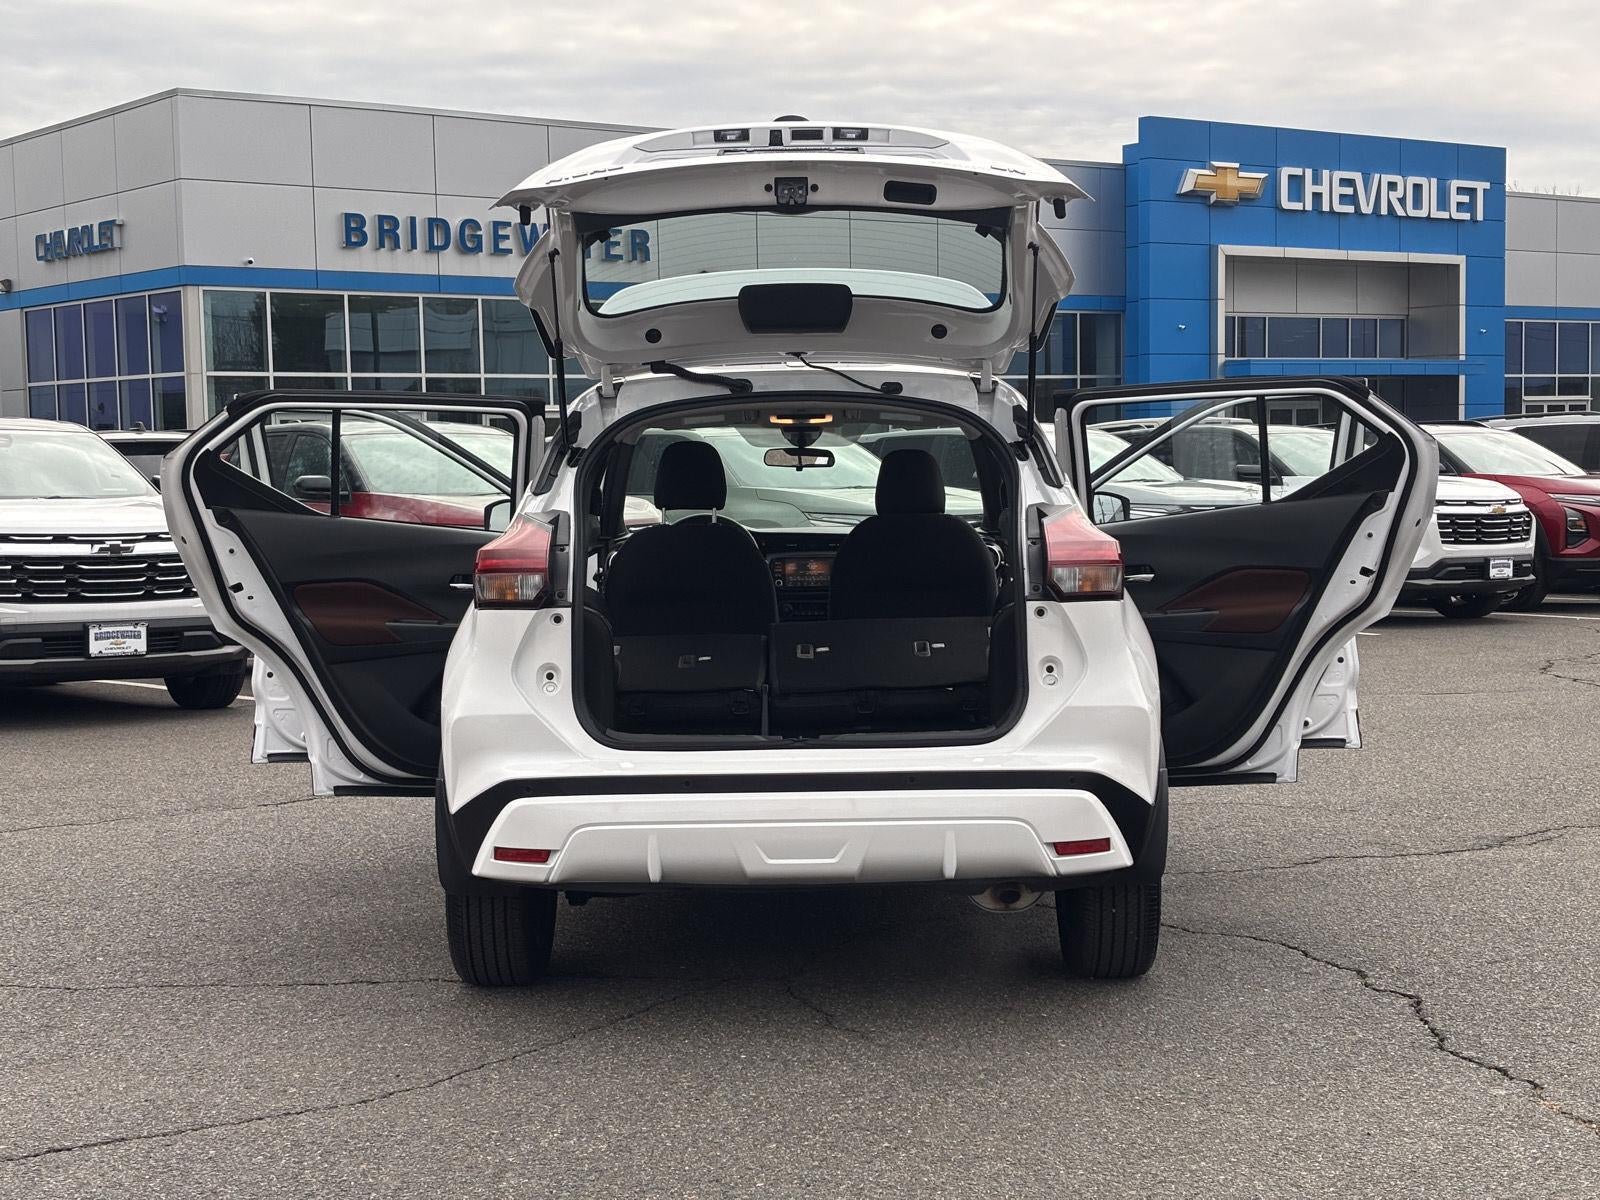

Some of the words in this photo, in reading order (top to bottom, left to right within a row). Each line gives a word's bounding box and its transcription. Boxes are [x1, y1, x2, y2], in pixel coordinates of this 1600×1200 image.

[1279, 166, 1491, 221] CHEVROLET
[35, 219, 123, 262] CHEVROLET
[342, 212, 650, 262] BRIDGEWER
[94, 630, 142, 641] BRIDGEWATER
